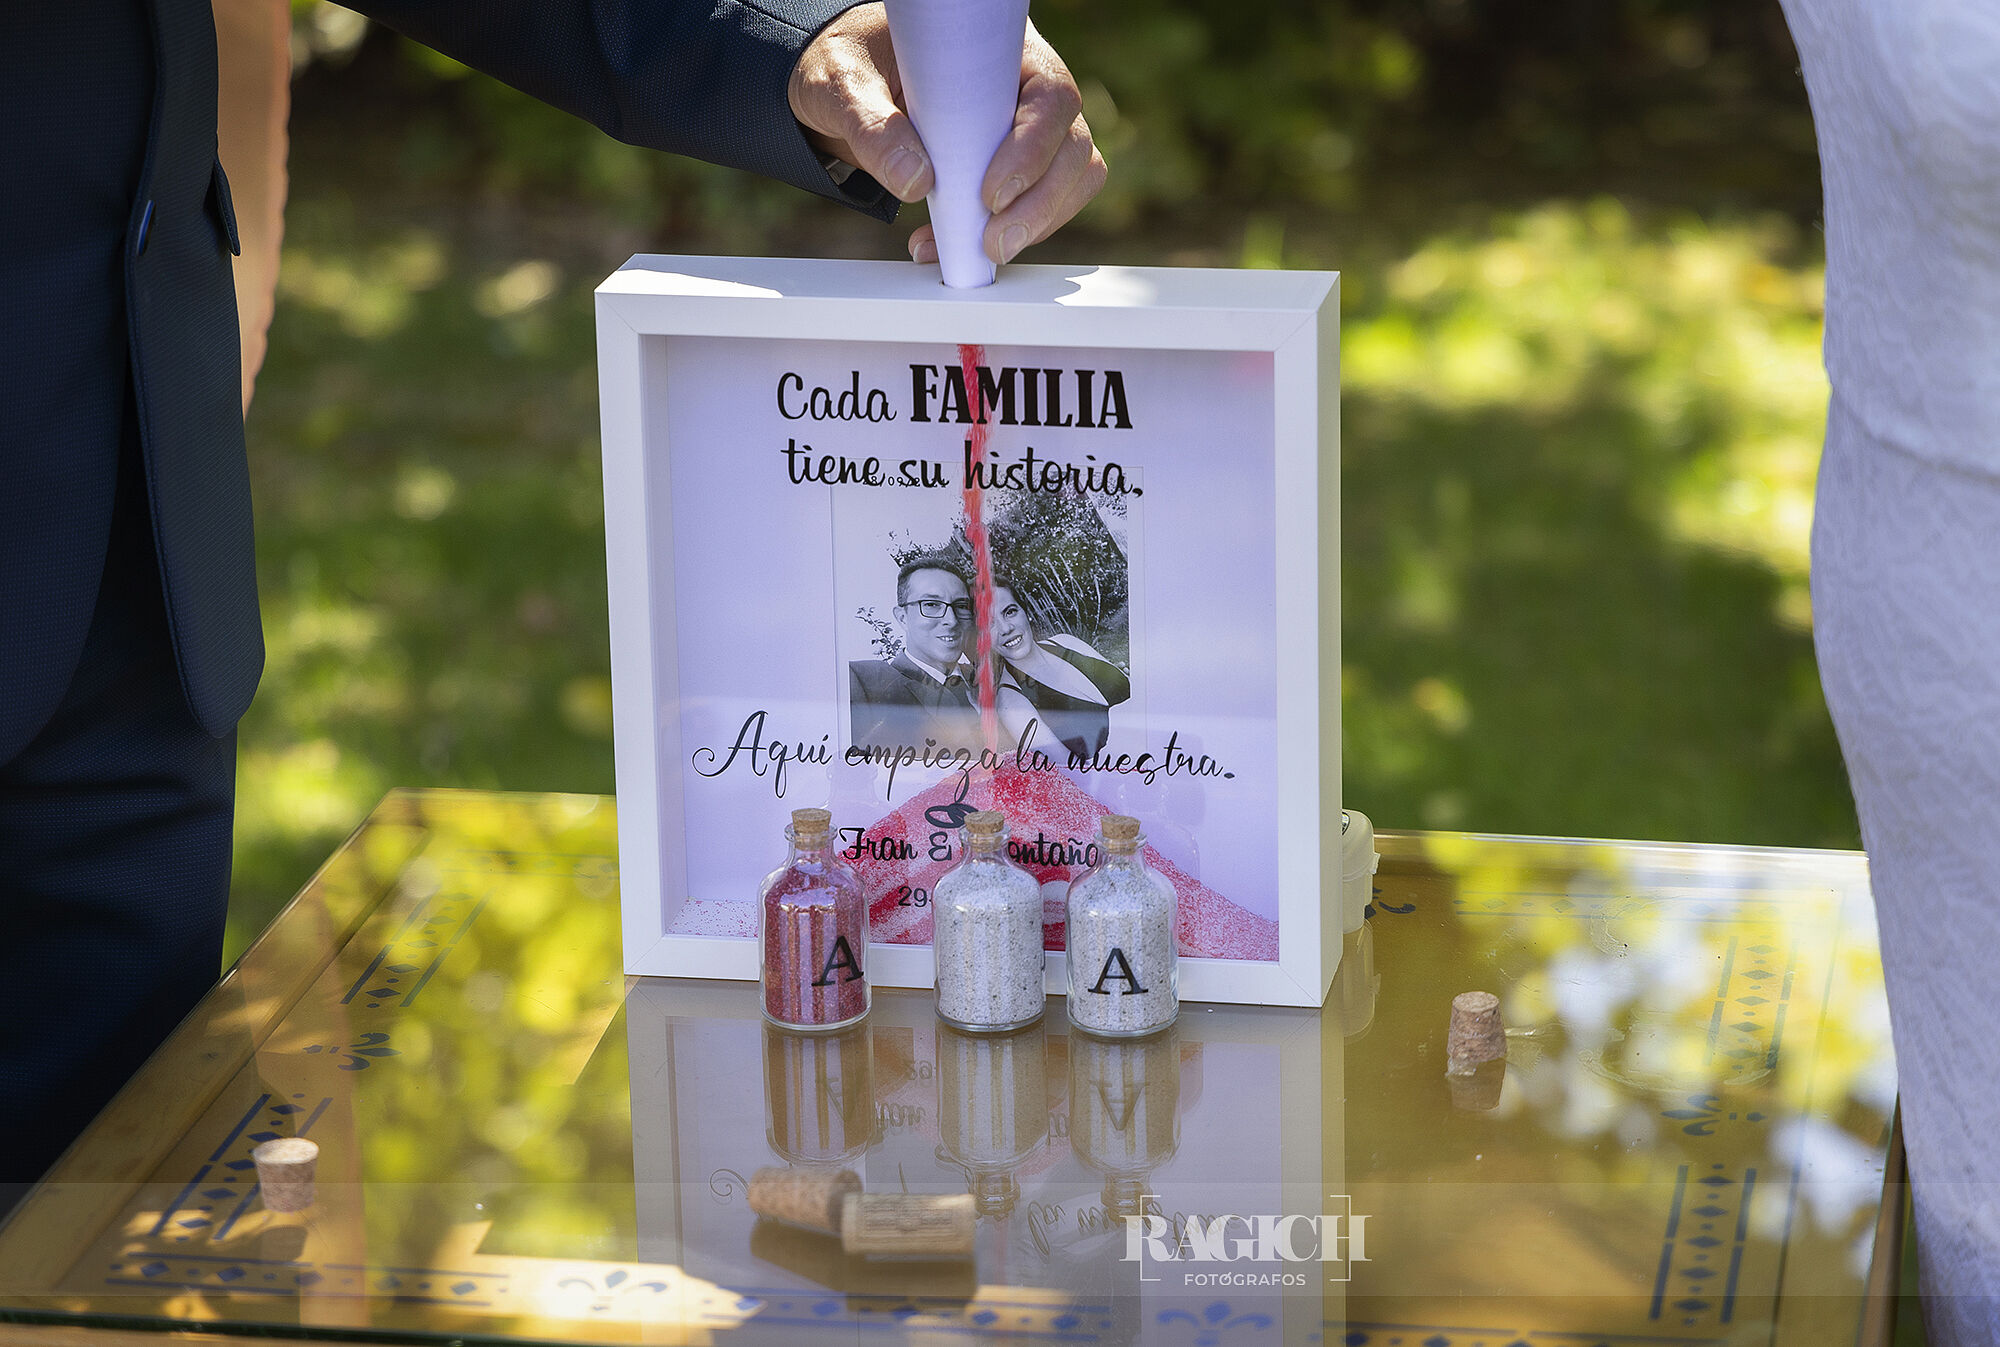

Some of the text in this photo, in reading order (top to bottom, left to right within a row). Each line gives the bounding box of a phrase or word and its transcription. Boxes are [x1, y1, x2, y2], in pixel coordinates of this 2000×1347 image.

[776, 364, 1134, 429] Cada FAMILIA
[780, 438, 886, 486] tiene
[899, 458, 950, 488] su
[692, 710, 833, 798] Aquí
[845, 737, 1004, 803] empieza
[1016, 718, 1056, 774] la
[811, 935, 864, 987] A
[1088, 948, 1149, 995] A
